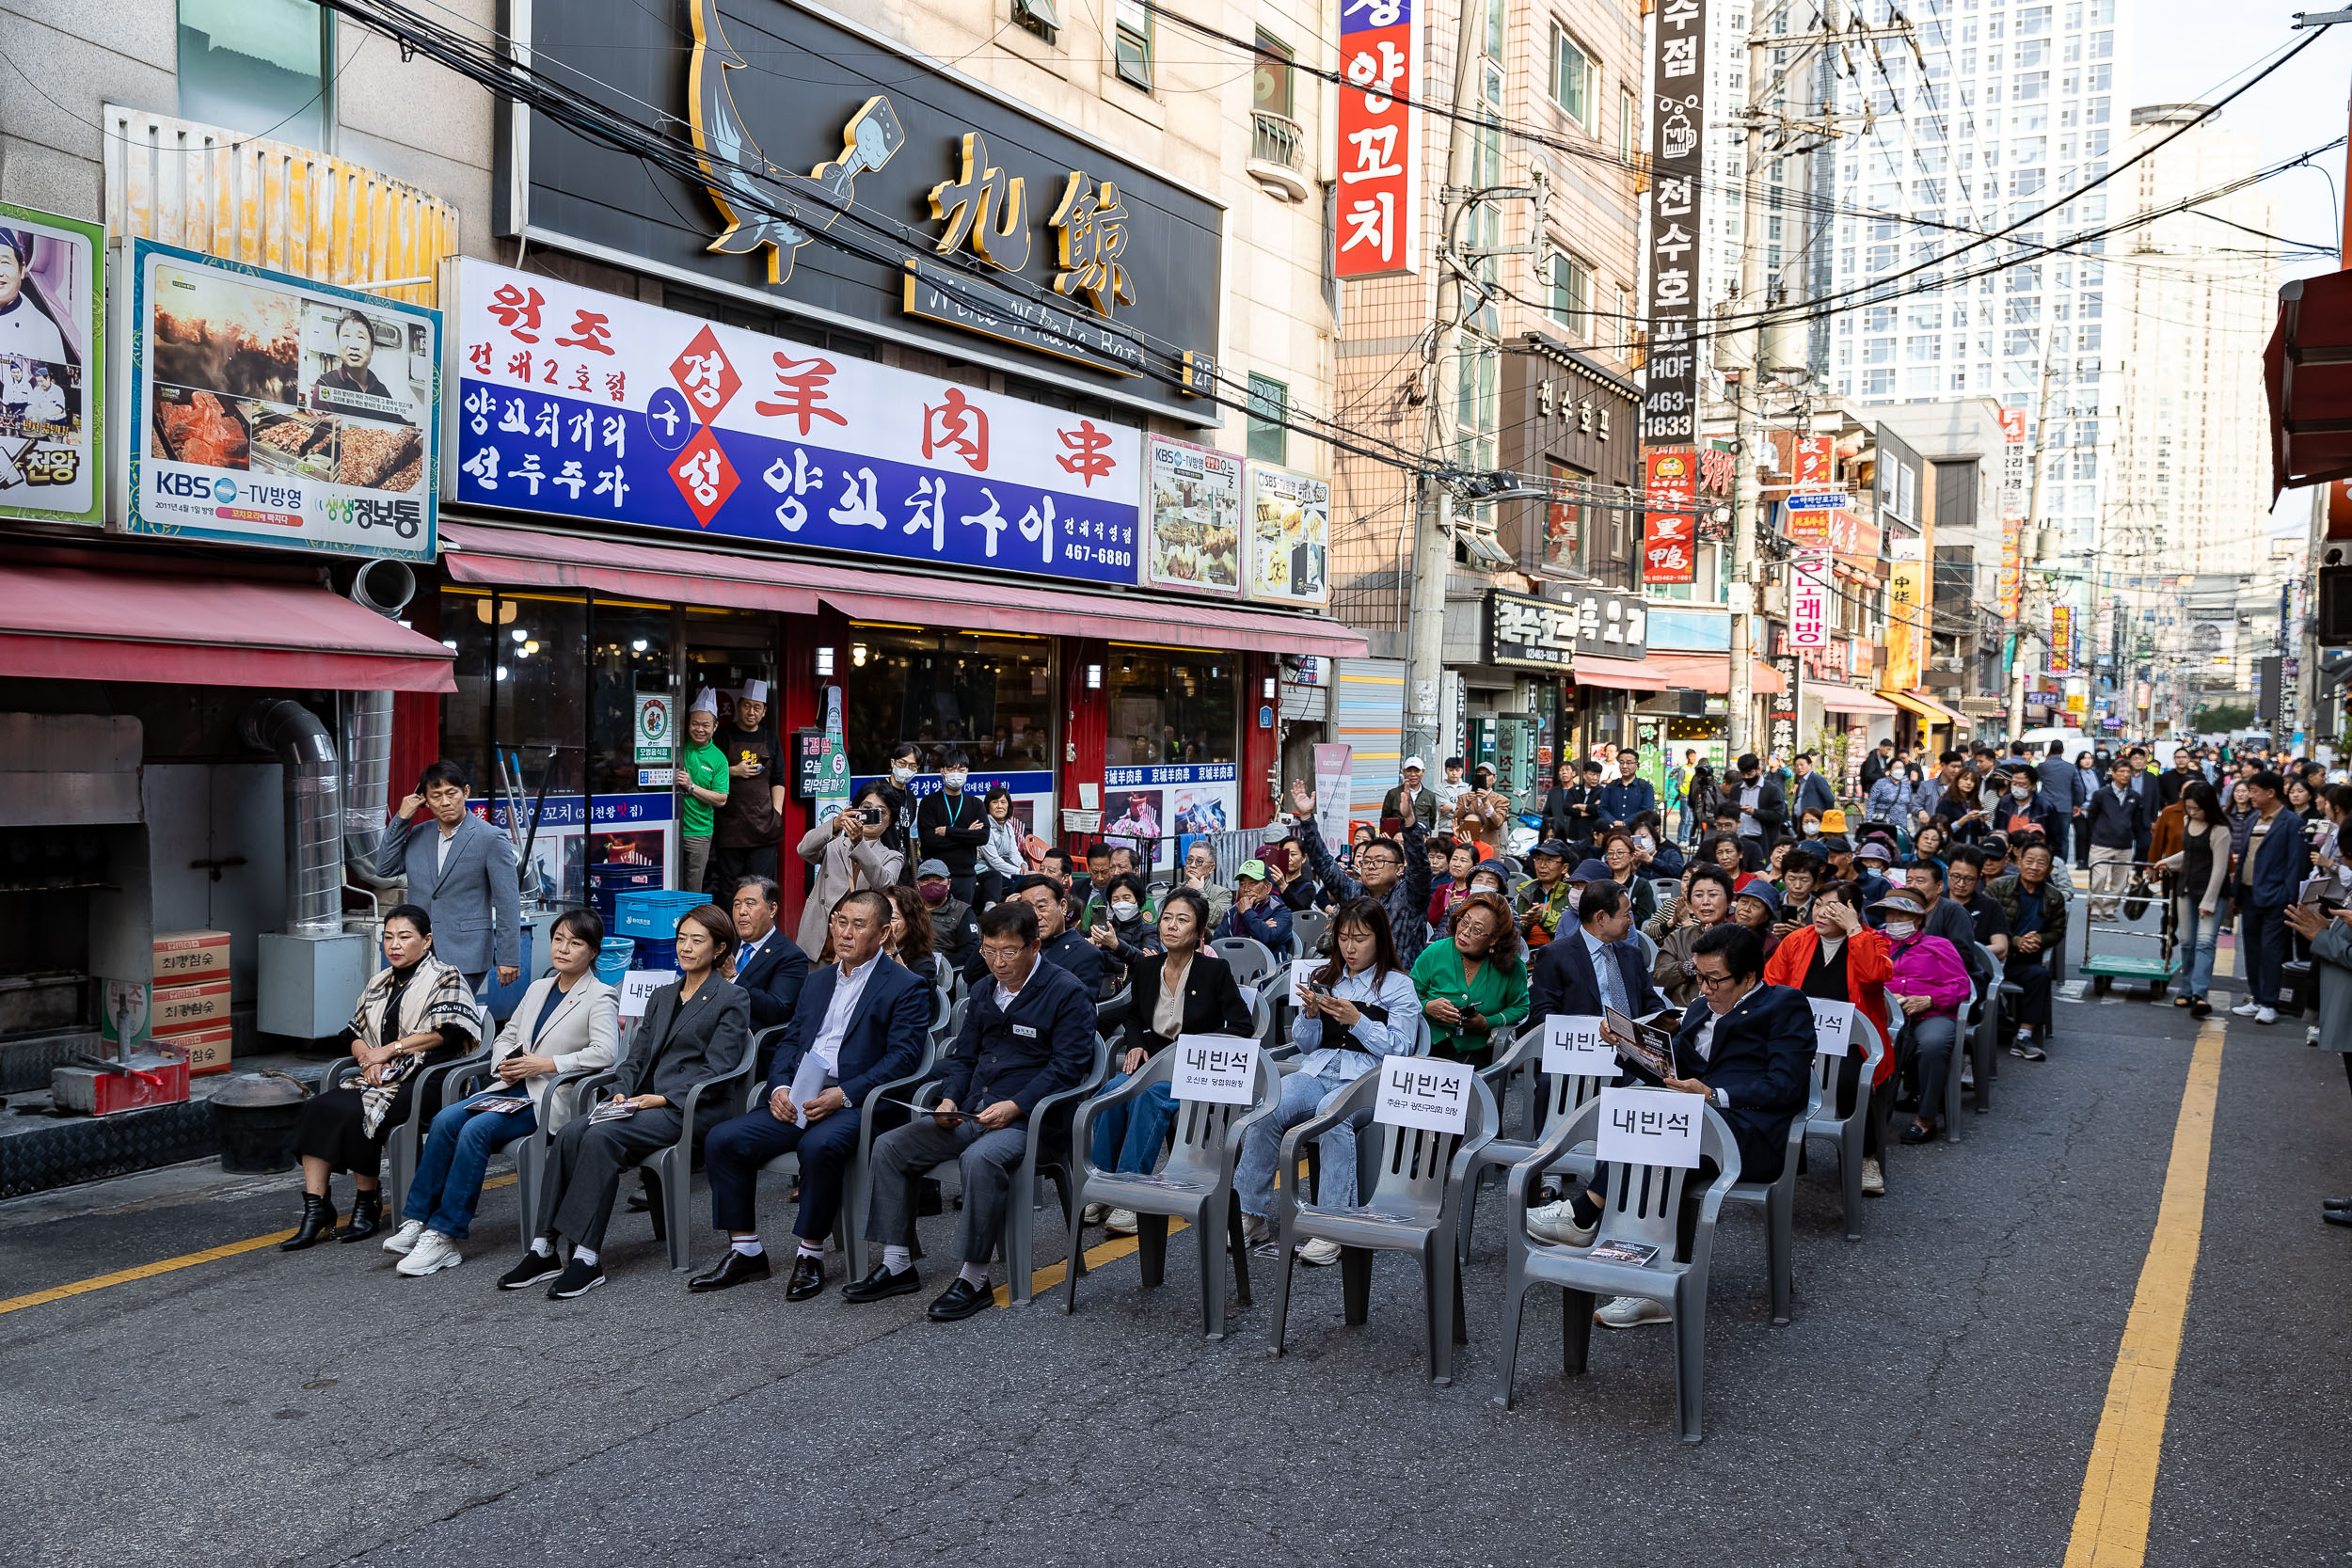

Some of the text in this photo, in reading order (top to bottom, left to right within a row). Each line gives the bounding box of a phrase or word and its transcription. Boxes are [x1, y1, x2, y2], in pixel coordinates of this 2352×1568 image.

[1341, 41, 1405, 262] 양꼬치
[486, 283, 616, 356] 원조
[1650, 356, 1692, 380] HOF
[1646, 391, 1694, 414] 463-
[464, 387, 627, 460] 양꼬치거리
[755, 350, 1118, 489] 羊肉串
[1645, 415, 1692, 437] 1833
[1155, 447, 1174, 464] KBS
[156, 470, 212, 499] KBS
[461, 445, 631, 509] 선두주자
[1264, 474, 1277, 488] SBS
[762, 447, 1057, 564] 양꼬치구이
[1064, 543, 1132, 567] 467-6880
[803, 759, 822, 774] 오늘
[1151, 767, 1191, 783] 京城羊肉串
[1198, 765, 1234, 781] 京城羊肉串
[803, 778, 846, 794] 뭐먹을까?
[629, 983, 663, 999] 내빈
[1186, 1048, 1248, 1074] 내빈석
[1391, 1069, 1460, 1101] 내빈석
[1445, 1106, 1458, 1117] 의장
[1613, 1107, 1690, 1138] 내빈석
